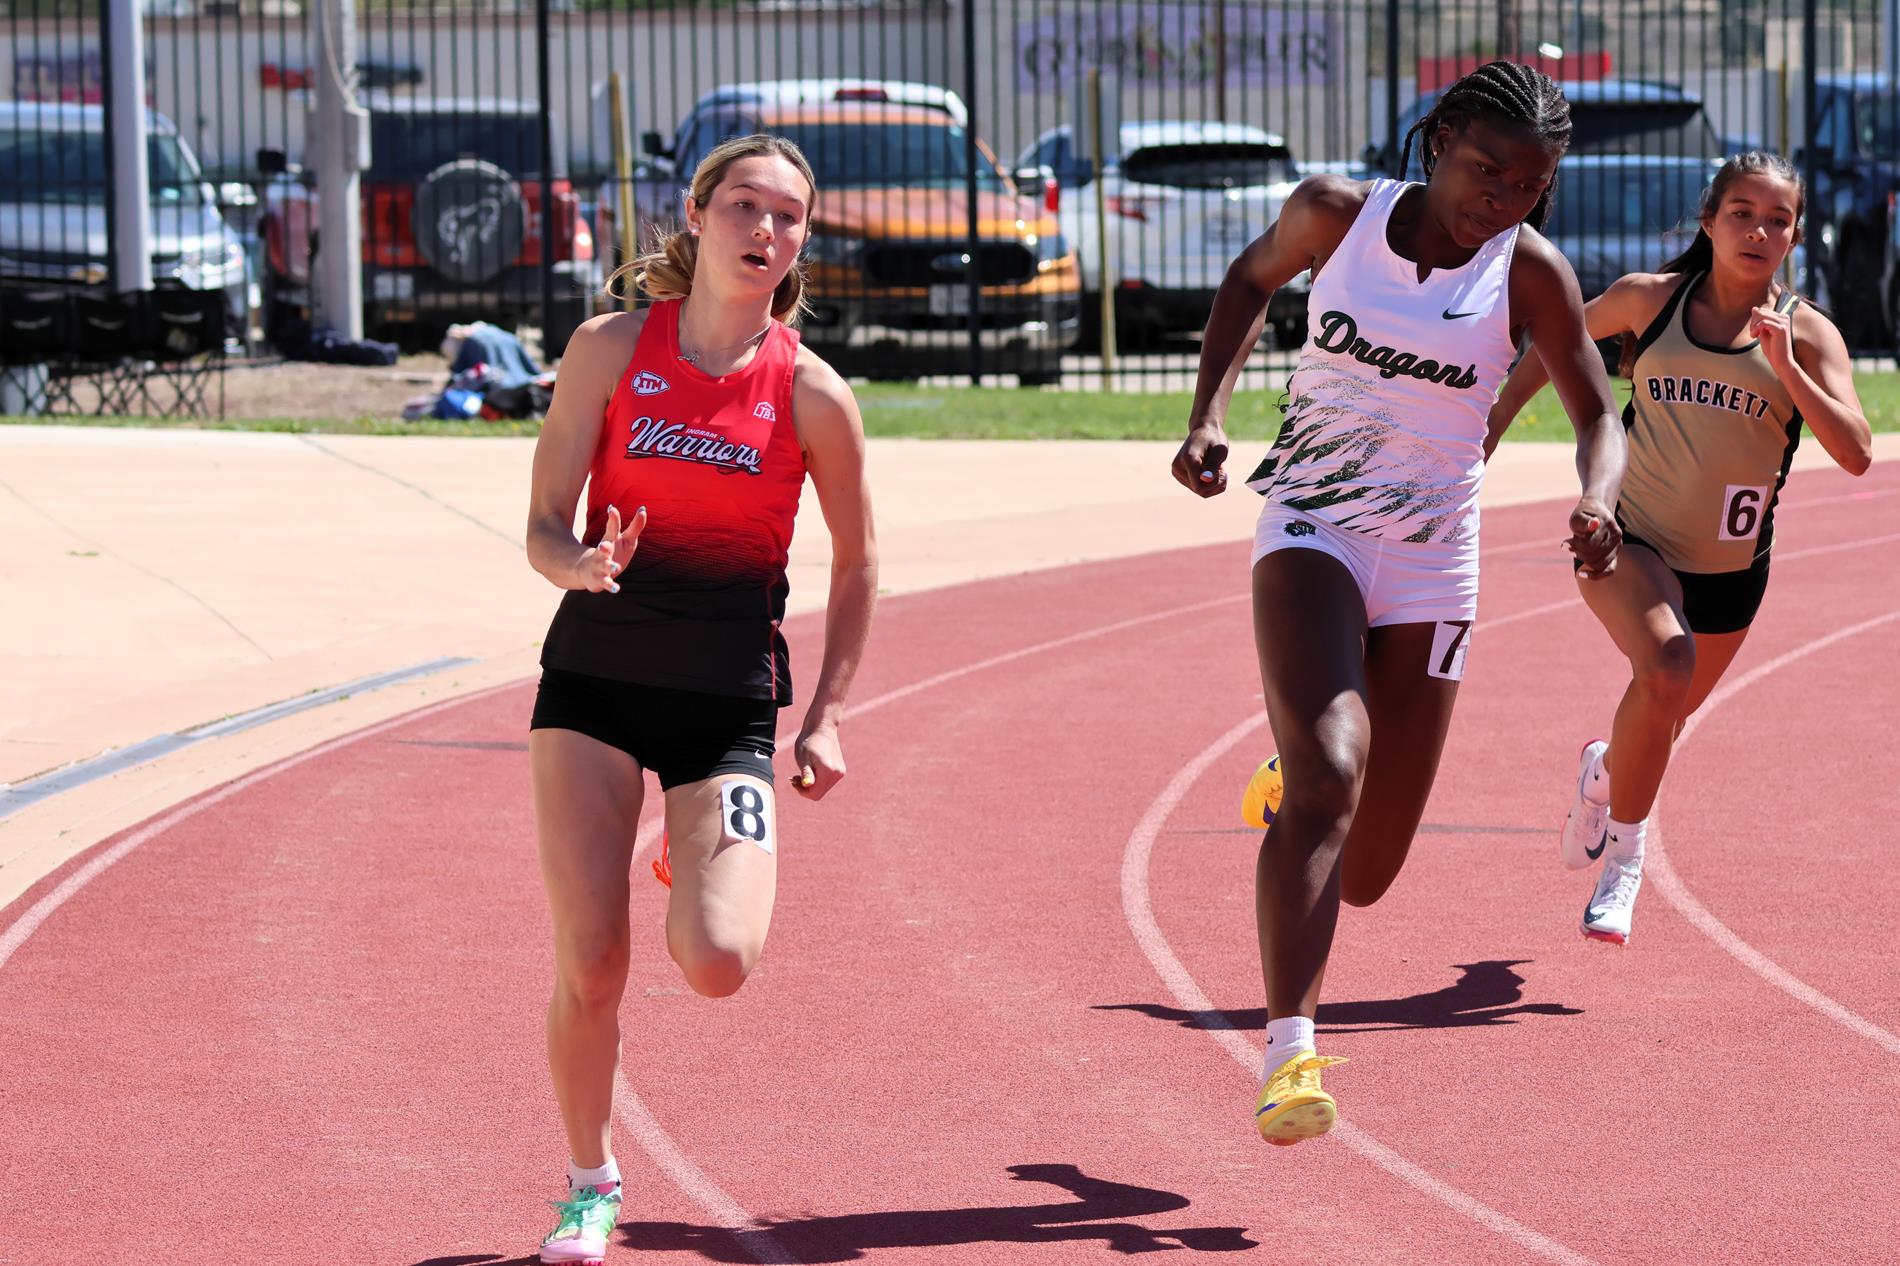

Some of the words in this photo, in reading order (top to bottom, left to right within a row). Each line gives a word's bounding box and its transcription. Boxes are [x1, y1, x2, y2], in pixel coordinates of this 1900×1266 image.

[1314, 310, 1478, 389] Dragons
[638, 376, 663, 391] ITM
[1647, 376, 1769, 419] BRACKETT
[627, 416, 762, 467] Warriors
[685, 428, 718, 438] INGRAM
[1726, 489, 1760, 537] 6
[1438, 620, 1471, 674] 7
[730, 785, 765, 841] 8
